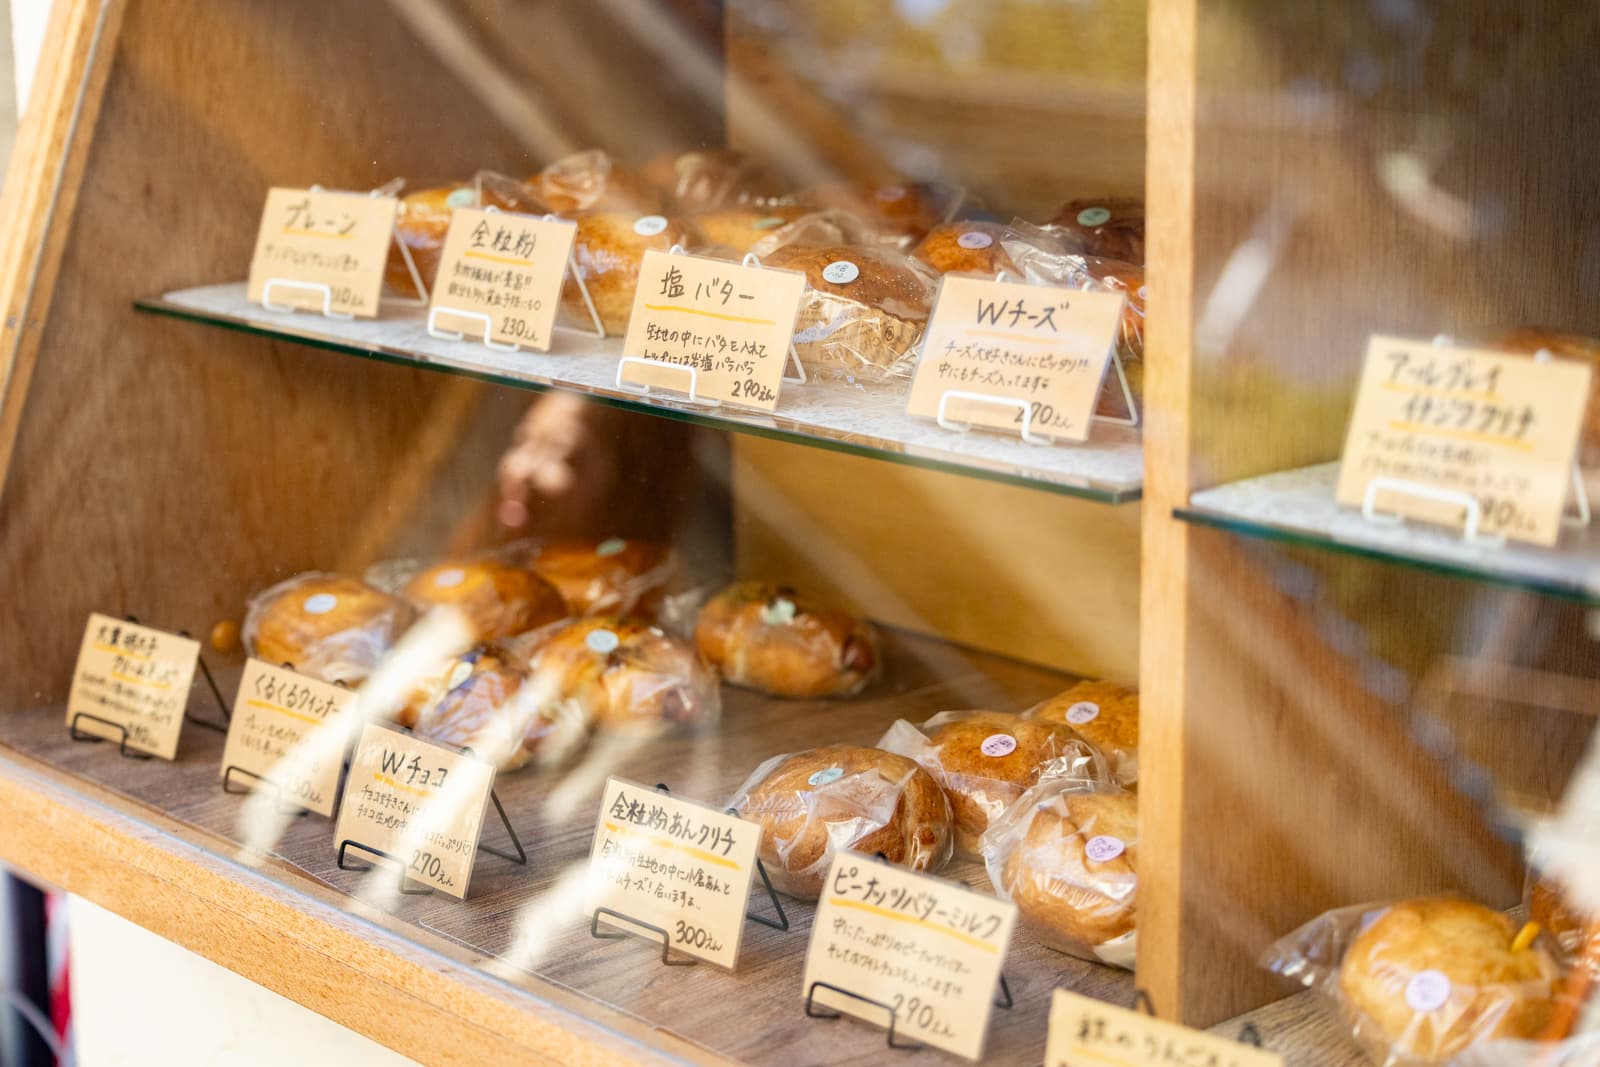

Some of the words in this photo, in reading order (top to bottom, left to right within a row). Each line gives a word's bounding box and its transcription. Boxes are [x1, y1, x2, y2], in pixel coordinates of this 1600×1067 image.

[285, 199, 356, 236] プレーン
[471, 219, 537, 259] 全粒粉
[977, 298, 1069, 332] Wチーズ
[381, 749, 448, 788] Wチョコ
[608, 791, 736, 856] 全粒粉あんクリチ
[833, 866, 1003, 939] ピーナッツバターミルク
[675, 920, 722, 951] 300えん
